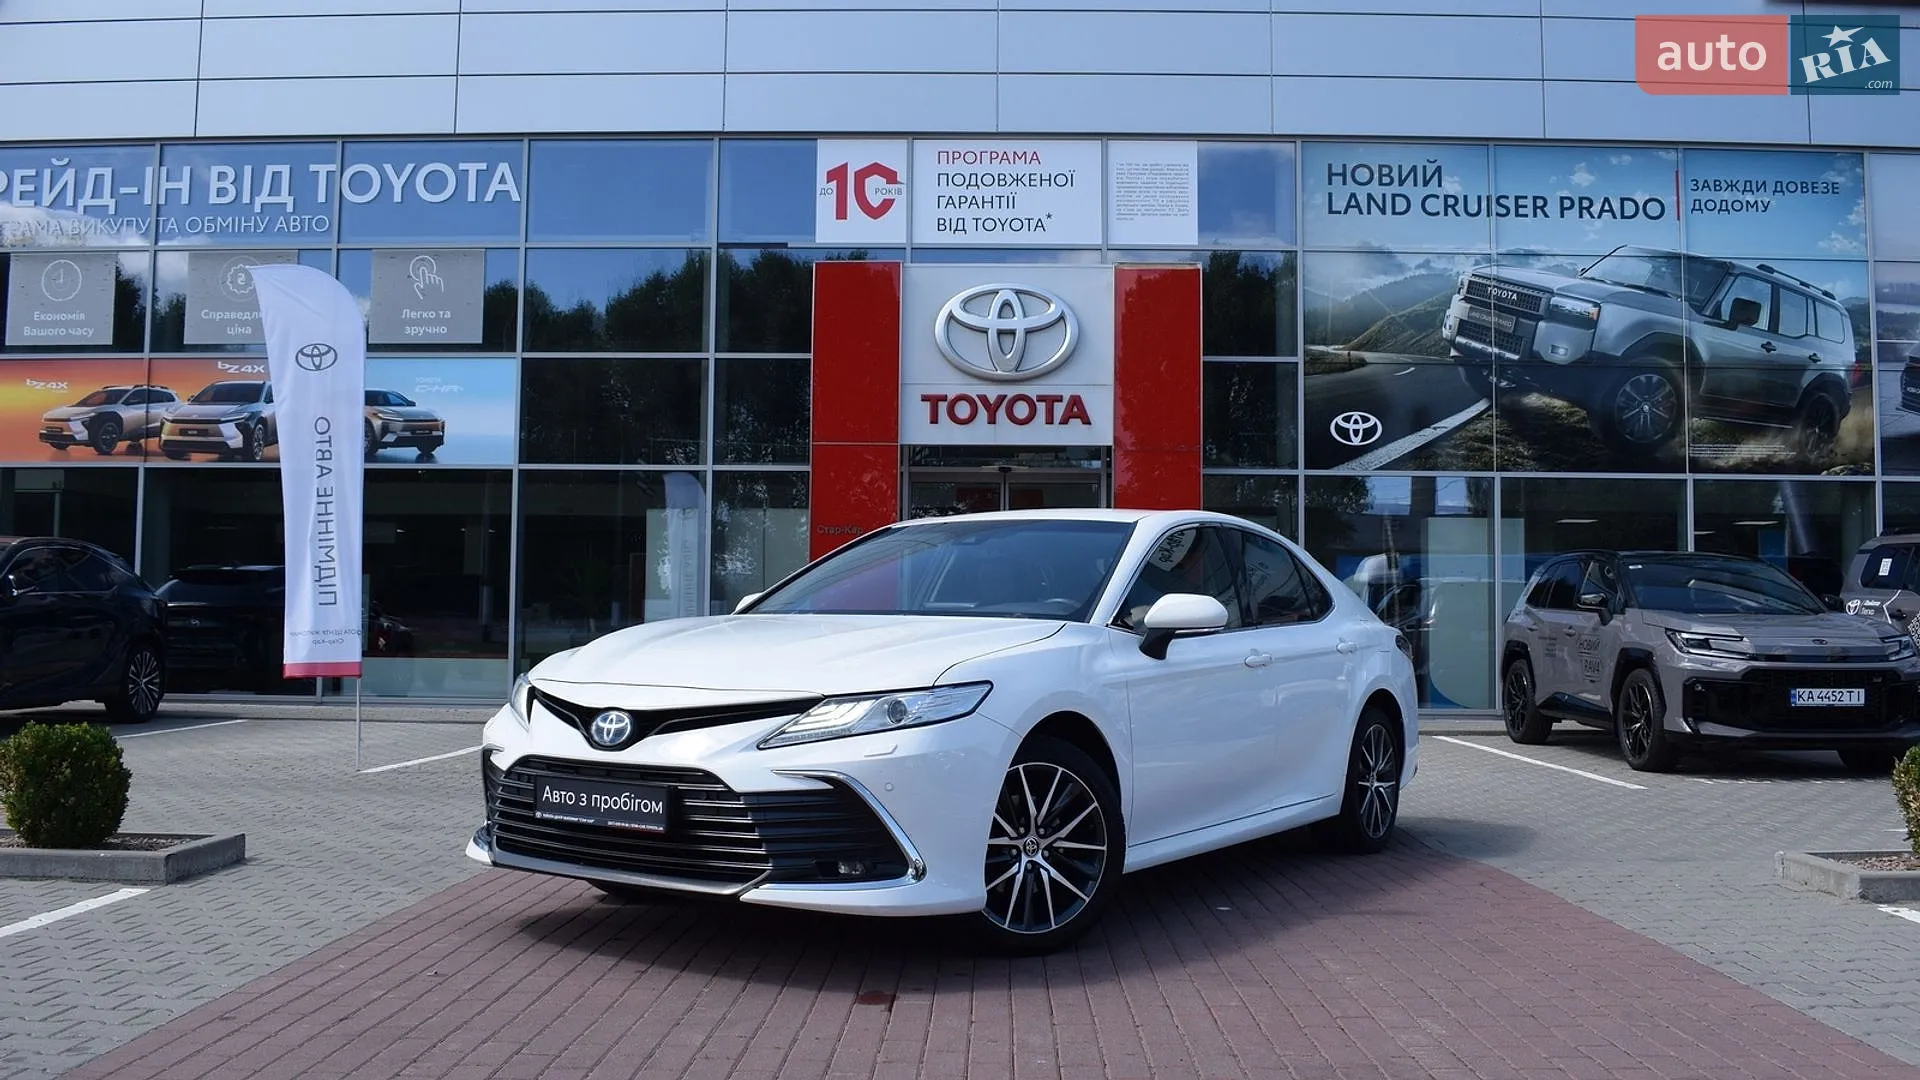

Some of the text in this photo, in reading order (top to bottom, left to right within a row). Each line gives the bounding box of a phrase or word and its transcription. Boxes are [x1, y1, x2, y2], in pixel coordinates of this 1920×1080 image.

[937, 151, 1041, 165] ПРОГРАМА
[937, 169, 1076, 189] ПОДОВЖЕНОЇ
[1327, 158, 1443, 188] НОВИЙ
[208, 164, 295, 214] ВІД
[309, 162, 521, 204] TOYOTA
[819, 187, 834, 196] ДО
[875, 188, 903, 196] РОКІВ
[1690, 179, 1840, 195] ЗАВЖДИ ДОВЕЗЕ
[937, 192, 1017, 210] ГАРАНТІЇ
[1327, 192, 1666, 221] LAND CRUISER PRADO
[1690, 198, 1771, 215] ДОДОМУ
[71, 216, 150, 236] ВИКУПУ
[157, 216, 179, 233] ТА
[185, 215, 269, 234] ОБМІНУ
[274, 214, 330, 233] АВТО
[937, 217, 967, 235] ВІД
[1486, 286, 1518, 301] TOYOTA
[33, 311, 86, 321] Економія
[200, 309, 262, 322] Справедл
[401, 309, 452, 319] Легко та
[23, 326, 95, 338] Вашого часу
[226, 325, 252, 337] ціна
[404, 326, 448, 336] зручно
[920, 393, 1092, 426] TOYOTA
[1797, 690, 1860, 702] KA 4452 TI
[542, 784, 664, 815] Авто з пробігом
